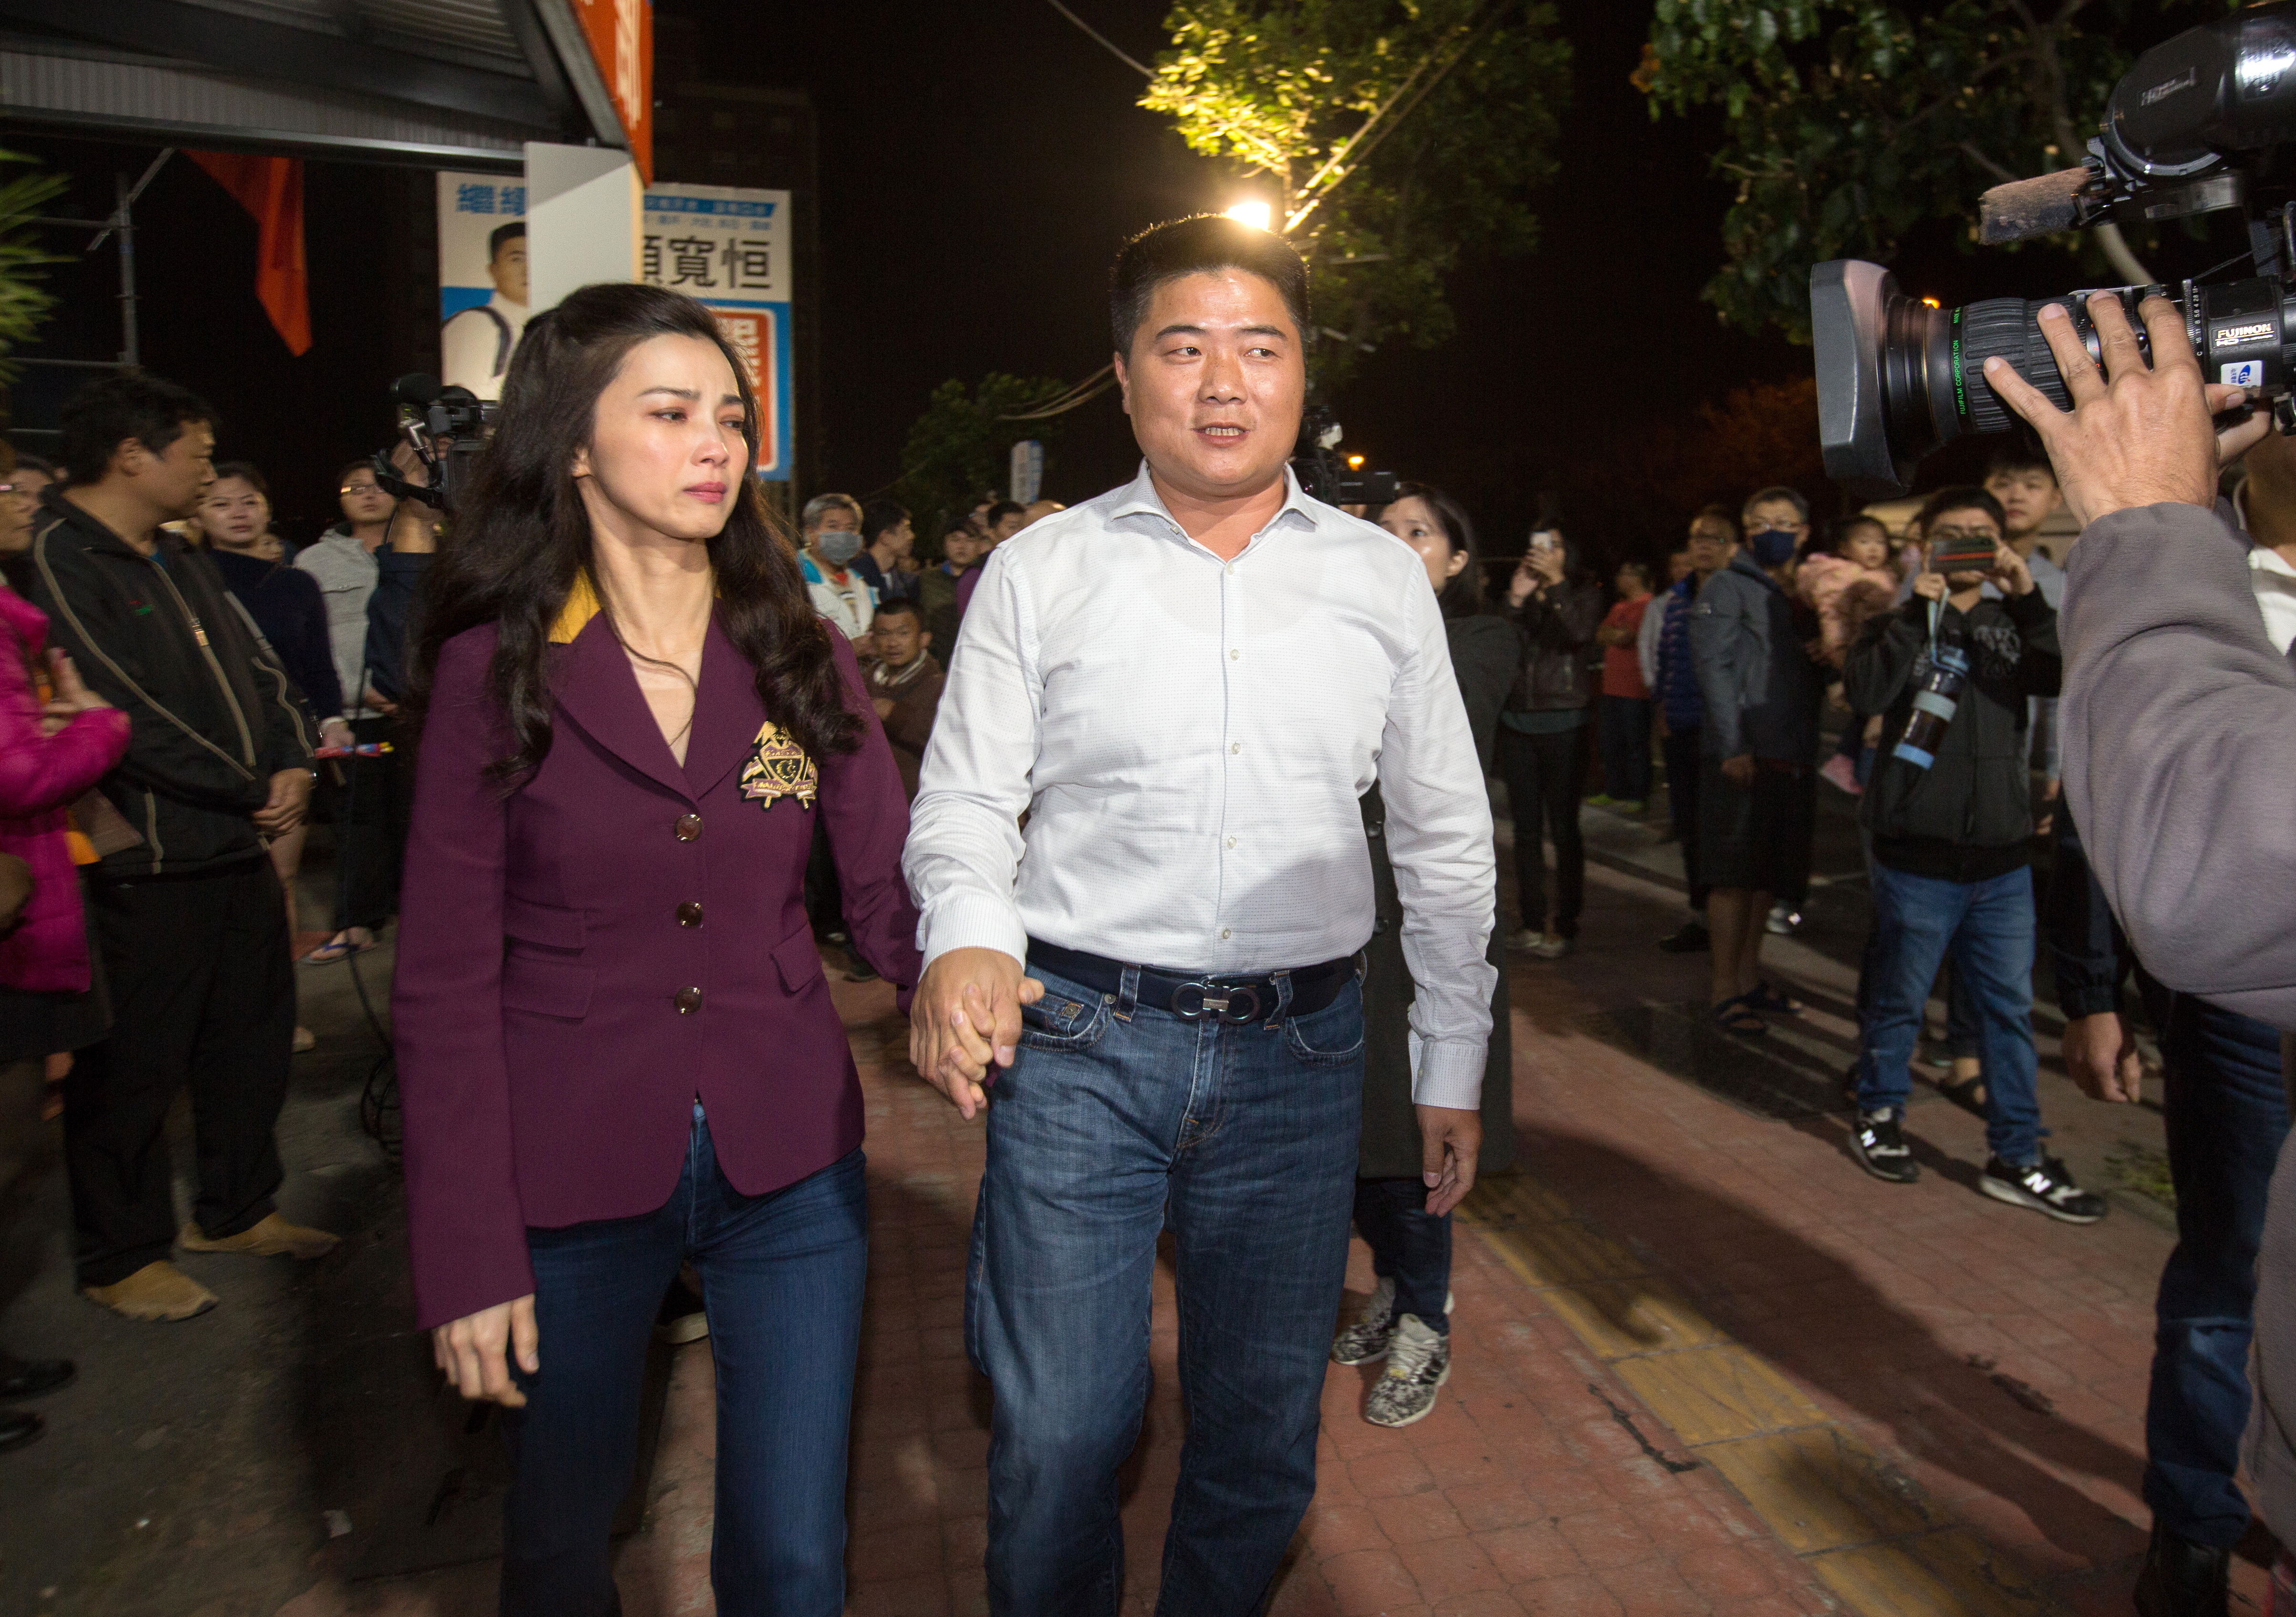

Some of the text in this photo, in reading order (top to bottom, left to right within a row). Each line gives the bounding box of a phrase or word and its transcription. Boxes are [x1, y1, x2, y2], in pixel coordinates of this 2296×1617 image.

[2217, 323, 2272, 339] FUJINON
[1953, 340, 1962, 386] CORPORATION
[1957, 388, 1965, 414] FUJIFILM
